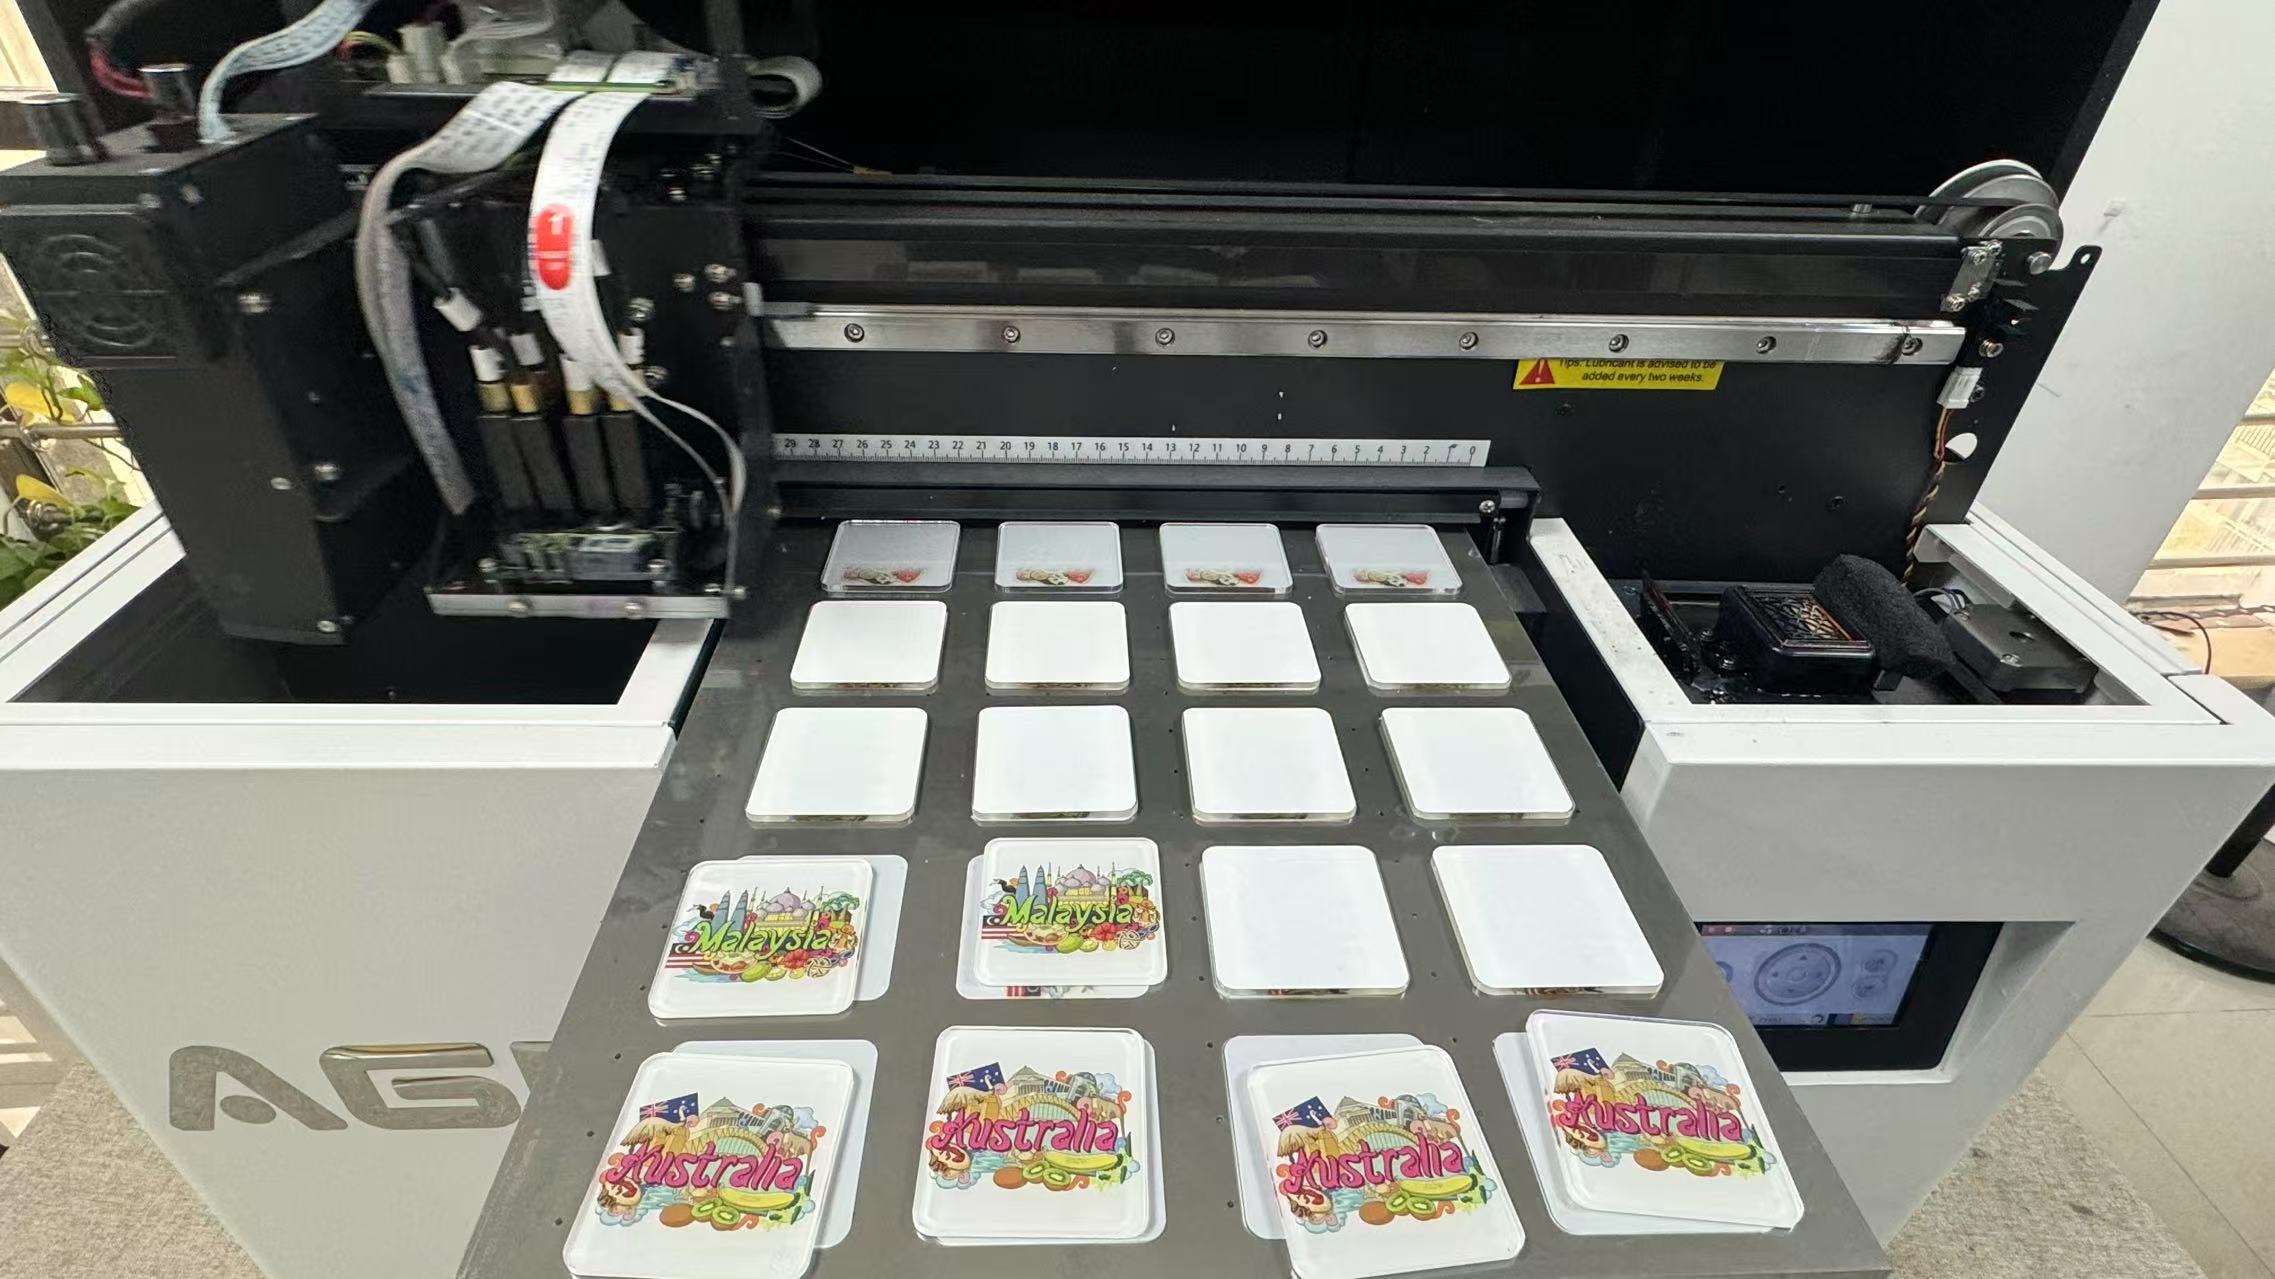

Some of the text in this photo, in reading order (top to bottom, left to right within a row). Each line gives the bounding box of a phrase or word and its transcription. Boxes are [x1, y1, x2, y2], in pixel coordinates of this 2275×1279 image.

[1582, 371, 1704, 384] added every two weeks.
[784, 438, 796, 448] 29
[808, 438, 820, 448] 28
[832, 439, 843, 448] 27
[857, 439, 868, 449] 26
[881, 439, 892, 449] 25
[904, 440, 916, 449] 24
[928, 440, 940, 449] 23
[952, 440, 964, 450] 22
[976, 441, 987, 450] 21
[1000, 441, 1012, 450] 20
[1024, 441, 1035, 450] 19
[1048, 441, 1059, 451] 18
[1071, 442, 1082, 451] 17
[1095, 442, 1106, 451] 16
[1118, 442, 1130, 451] 15
[1142, 442, 1153, 451] 14
[1165, 443, 1176, 452] 13
[1189, 443, 1200, 452] 12
[1213, 443, 1223, 452] 11
[1236, 443, 1247, 453] 10
[1000, 894, 1133, 933] Malaysia
[689, 919, 832, 960] Malaysia
[169, 1041, 553, 1131] AG
[931, 1106, 1118, 1153] Australia
[1557, 1091, 1743, 1141] Australia
[605, 1140, 803, 1191] Australia
[1283, 1131, 1465, 1193] Australia
